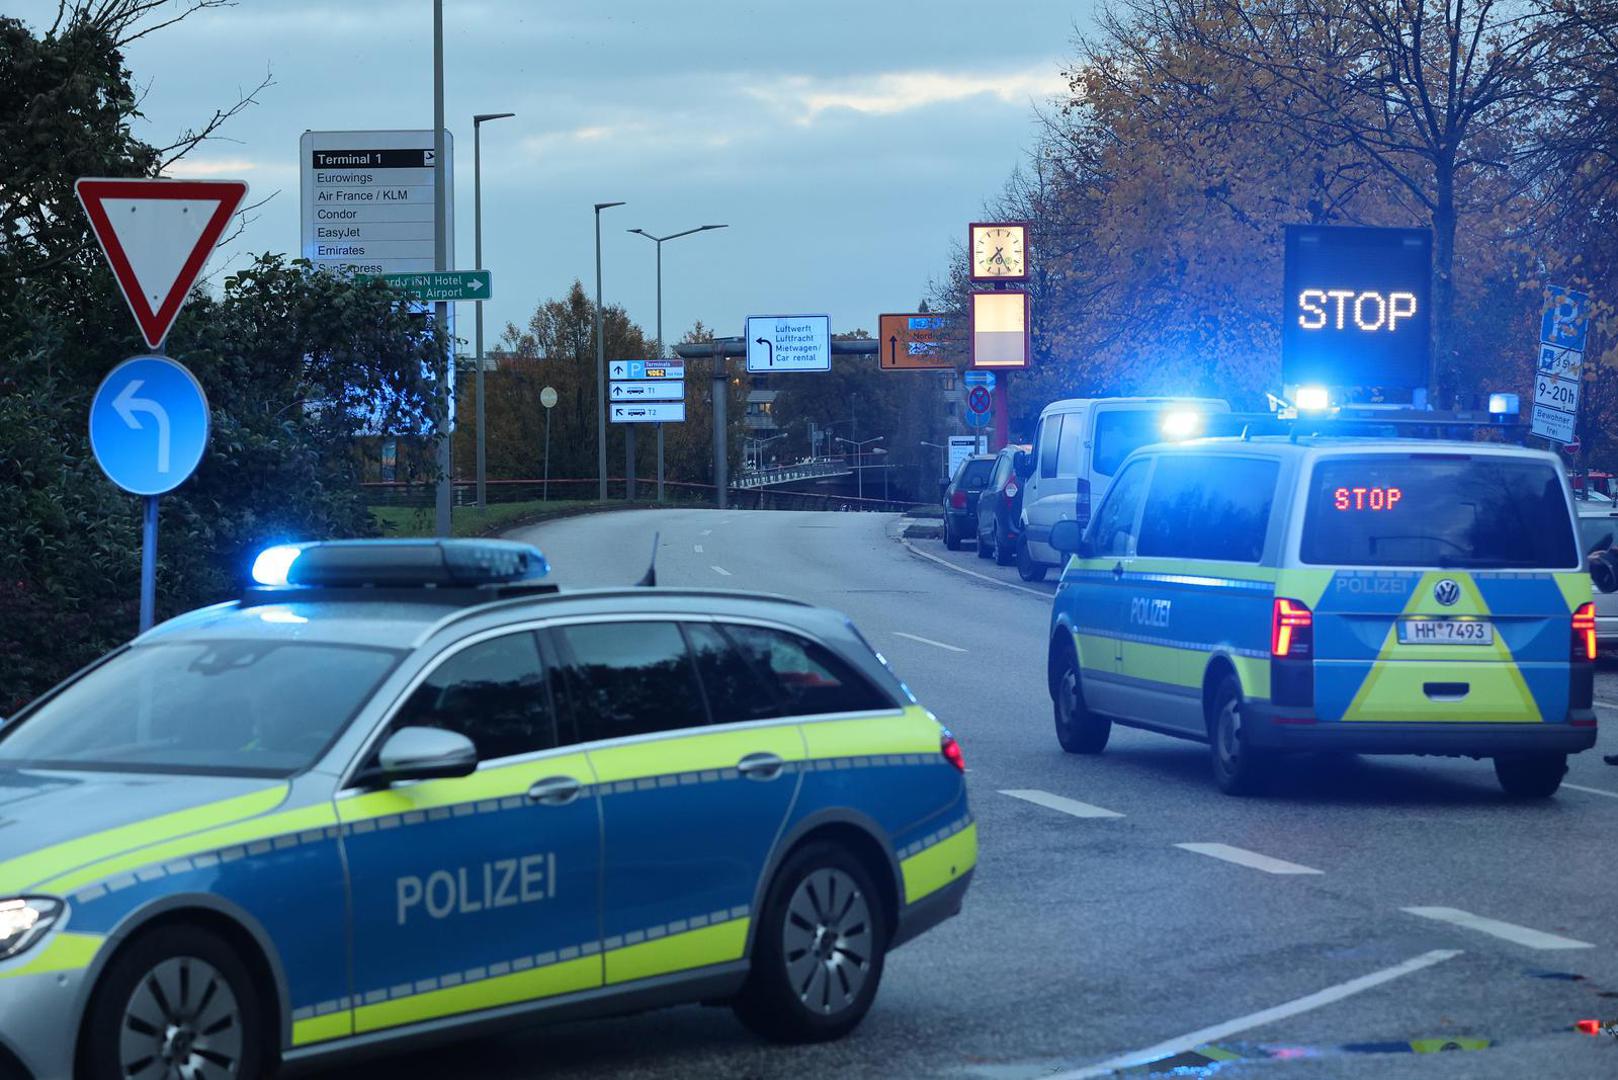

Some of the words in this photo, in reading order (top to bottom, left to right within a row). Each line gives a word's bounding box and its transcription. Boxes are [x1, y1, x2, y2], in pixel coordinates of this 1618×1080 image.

[317, 154, 371, 165] Terminal
[375, 153, 382, 164] 1
[317, 173, 374, 185] Eurowings
[318, 191, 334, 201] Air
[336, 190, 374, 201] France
[376, 191, 381, 201] /
[383, 190, 408, 200] KLM
[317, 209, 358, 220] Condor
[318, 227, 360, 240] EasyJet
[318, 246, 365, 256] Emirates
[434, 275, 462, 286] Hotel
[426, 287, 463, 299] Airport
[1299, 290, 1417, 332] STOP
[775, 325, 812, 333] Luftwerft
[775, 335, 814, 343] Luftfracht
[776, 354, 790, 362] Car
[631, 363, 640, 377] P
[1539, 382, 1575, 405] 9-20h
[1335, 488, 1401, 511] STOP
[1336, 578, 1408, 594] POLIZEI
[1130, 597, 1172, 628] POLIZEI
[1415, 623, 1436, 638] HH
[1446, 623, 1484, 639] 7493
[397, 852, 556, 926] POLIZEI
